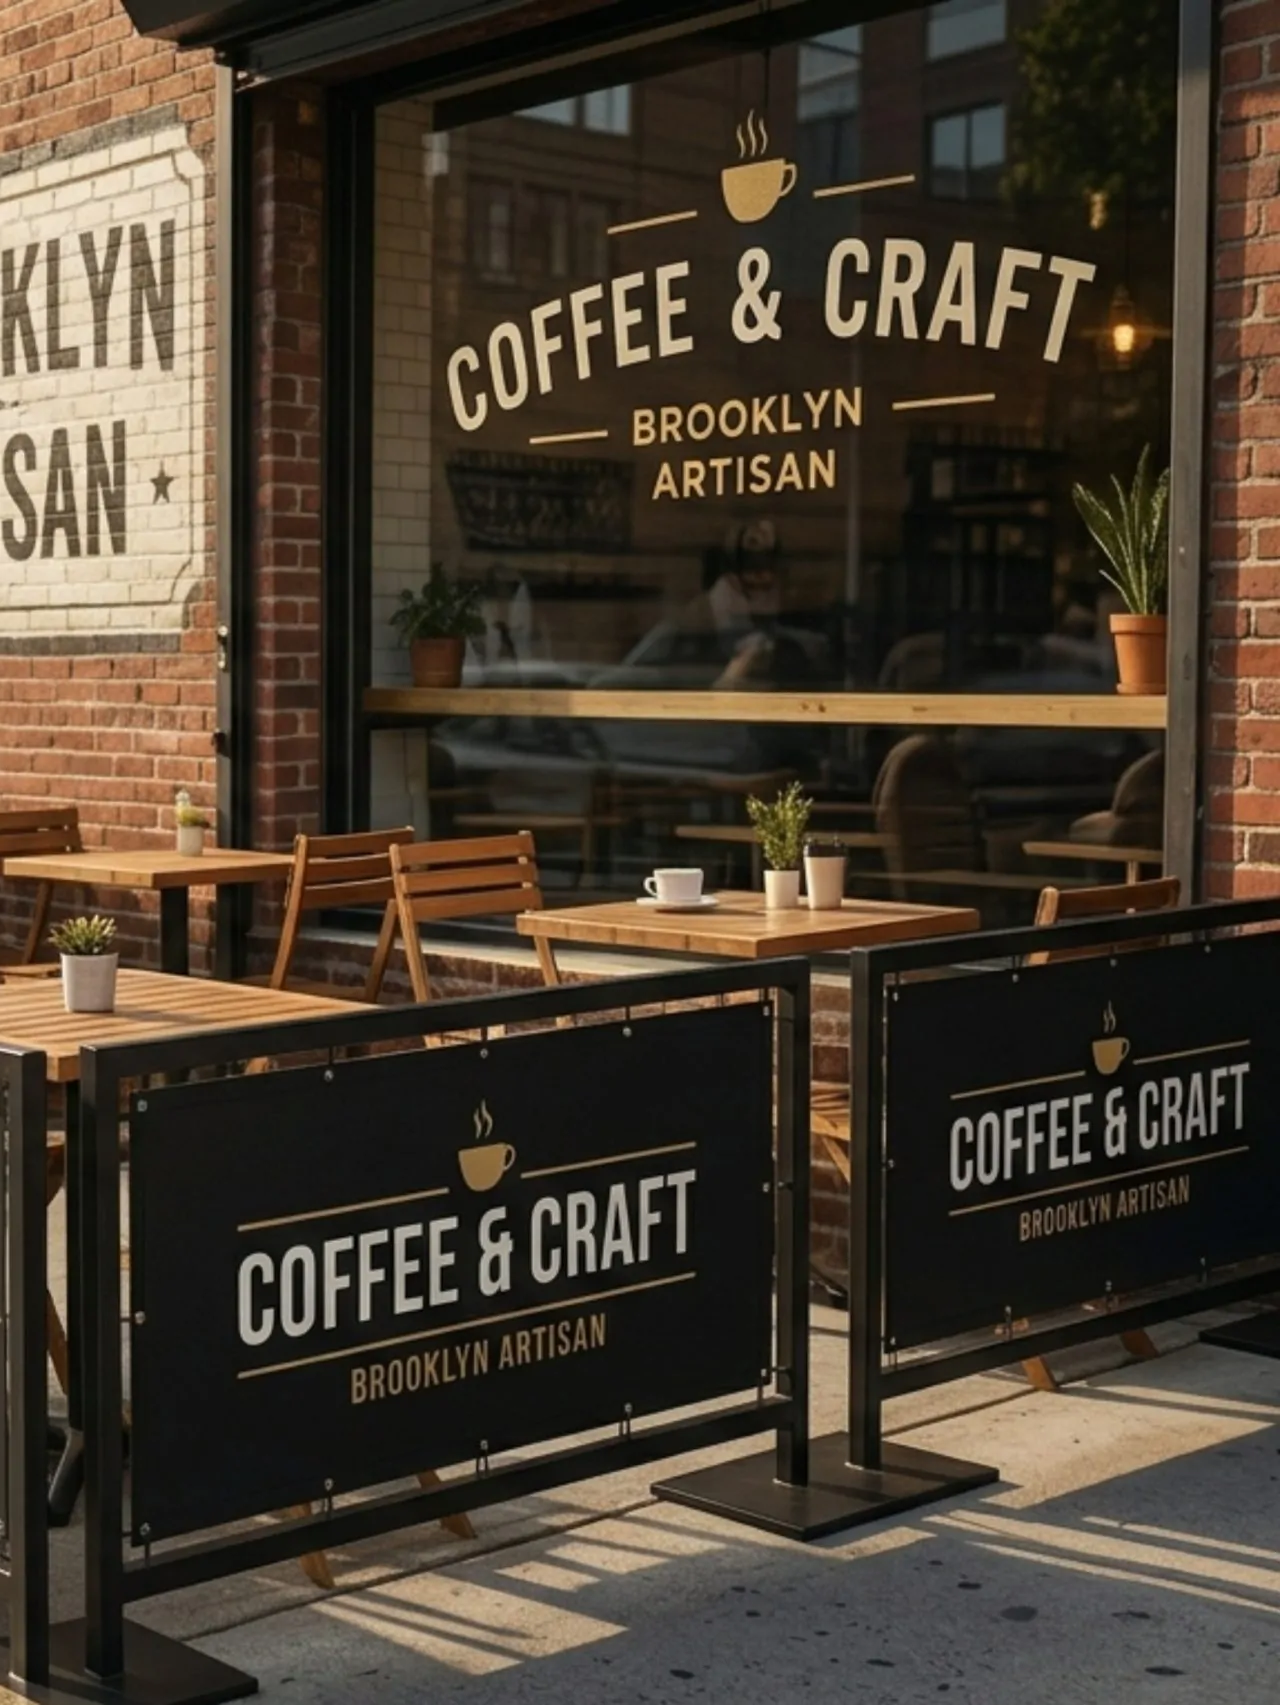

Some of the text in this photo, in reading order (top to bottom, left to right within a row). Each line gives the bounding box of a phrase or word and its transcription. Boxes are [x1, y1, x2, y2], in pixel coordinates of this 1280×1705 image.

[446, 238, 1097, 432] COFFEE & CRAFT
[632, 387, 862, 446] BROOKLYN
[651, 449, 836, 500] ARTISAN
[950, 1062, 1250, 1191] COFFEE & CRAFT
[1019, 1174, 1190, 1242] BROOKLYN ARTISAN
[238, 1169, 696, 1346] COFFEE & CRAFT
[351, 1313, 607, 1405] BROOKLYN ARTISAN
